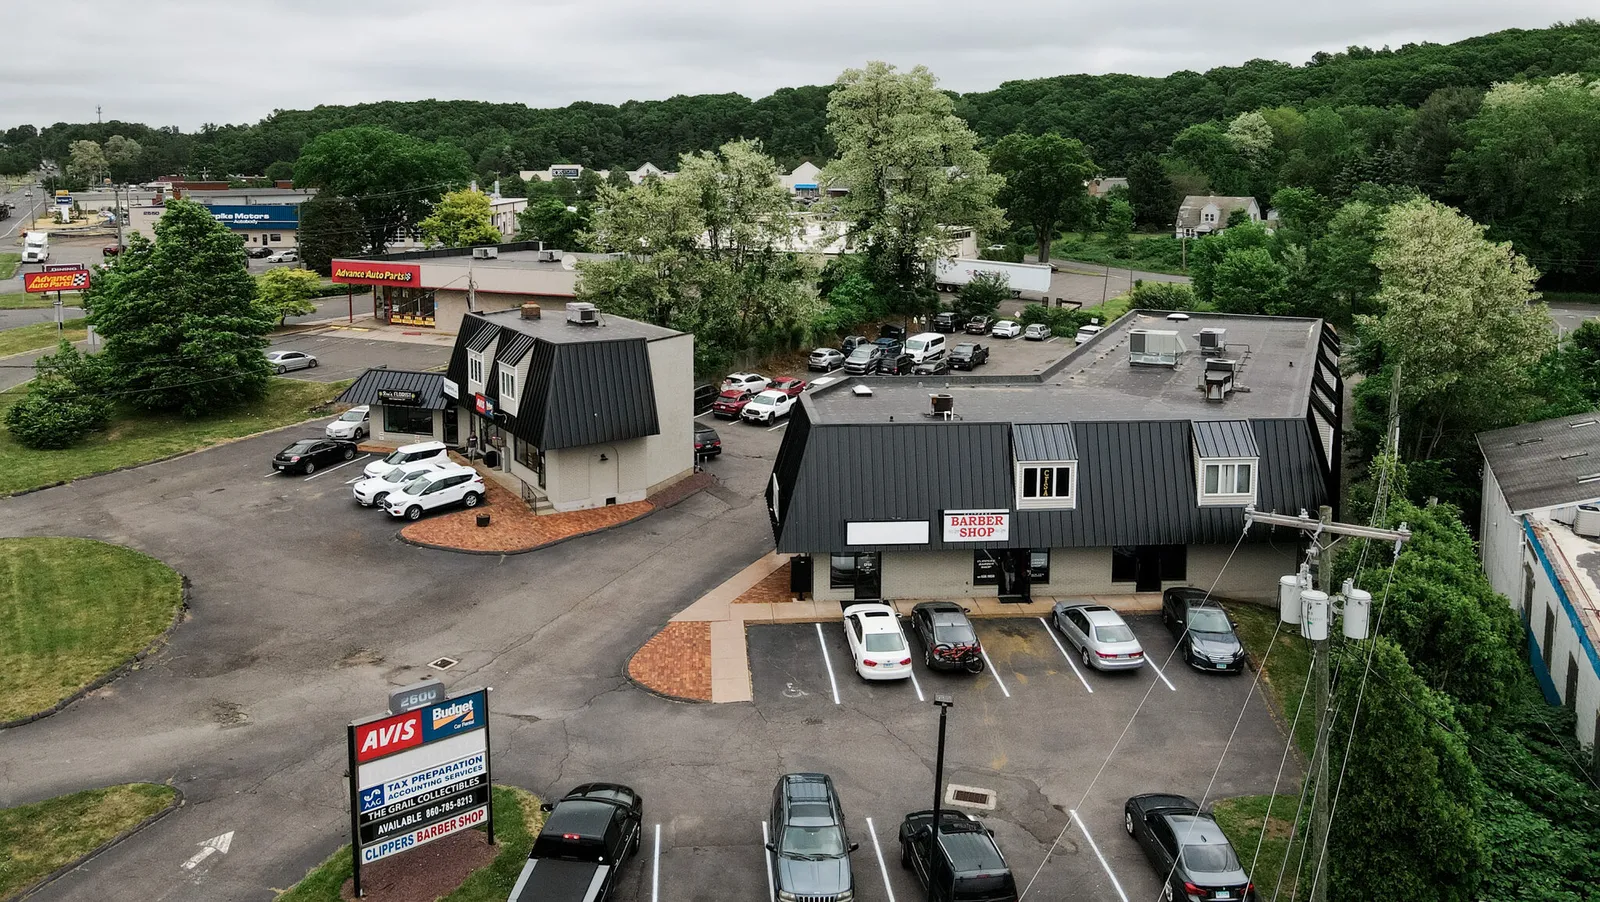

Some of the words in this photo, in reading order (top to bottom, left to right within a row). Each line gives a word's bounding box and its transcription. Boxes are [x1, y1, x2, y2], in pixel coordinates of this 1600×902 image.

[234, 212, 270, 220] Motors
[32, 275, 73, 283] Advance
[335, 268, 365, 279] Advance
[365, 270, 384, 279] Auto
[384, 271, 404, 281] Parts
[28, 281, 49, 290] Auto
[49, 280, 71, 288] Parts
[951, 515, 1004, 527] BARBER
[959, 527, 995, 537] SHOP
[400, 689, 437, 708] 2600
[432, 700, 474, 721] Budget
[453, 722, 462, 730] Car
[361, 719, 417, 753] AVIS
[387, 779, 408, 792] TAX
[411, 755, 483, 785] PREPARATION
[387, 778, 442, 800] ACCOUNTING
[444, 764, 483, 782] SERVICES
[364, 798, 382, 809] AAG
[367, 808, 387, 821] THE
[388, 798, 417, 814] GRAIL
[417, 777, 480, 805] COLLECTIBLES
[378, 811, 422, 835] AVAILABLE
[425, 795, 473, 819] 860-785-8213
[365, 834, 415, 861] CLIPPERS
[416, 819, 457, 843] BARBER
[458, 809, 484, 828] SHOP
